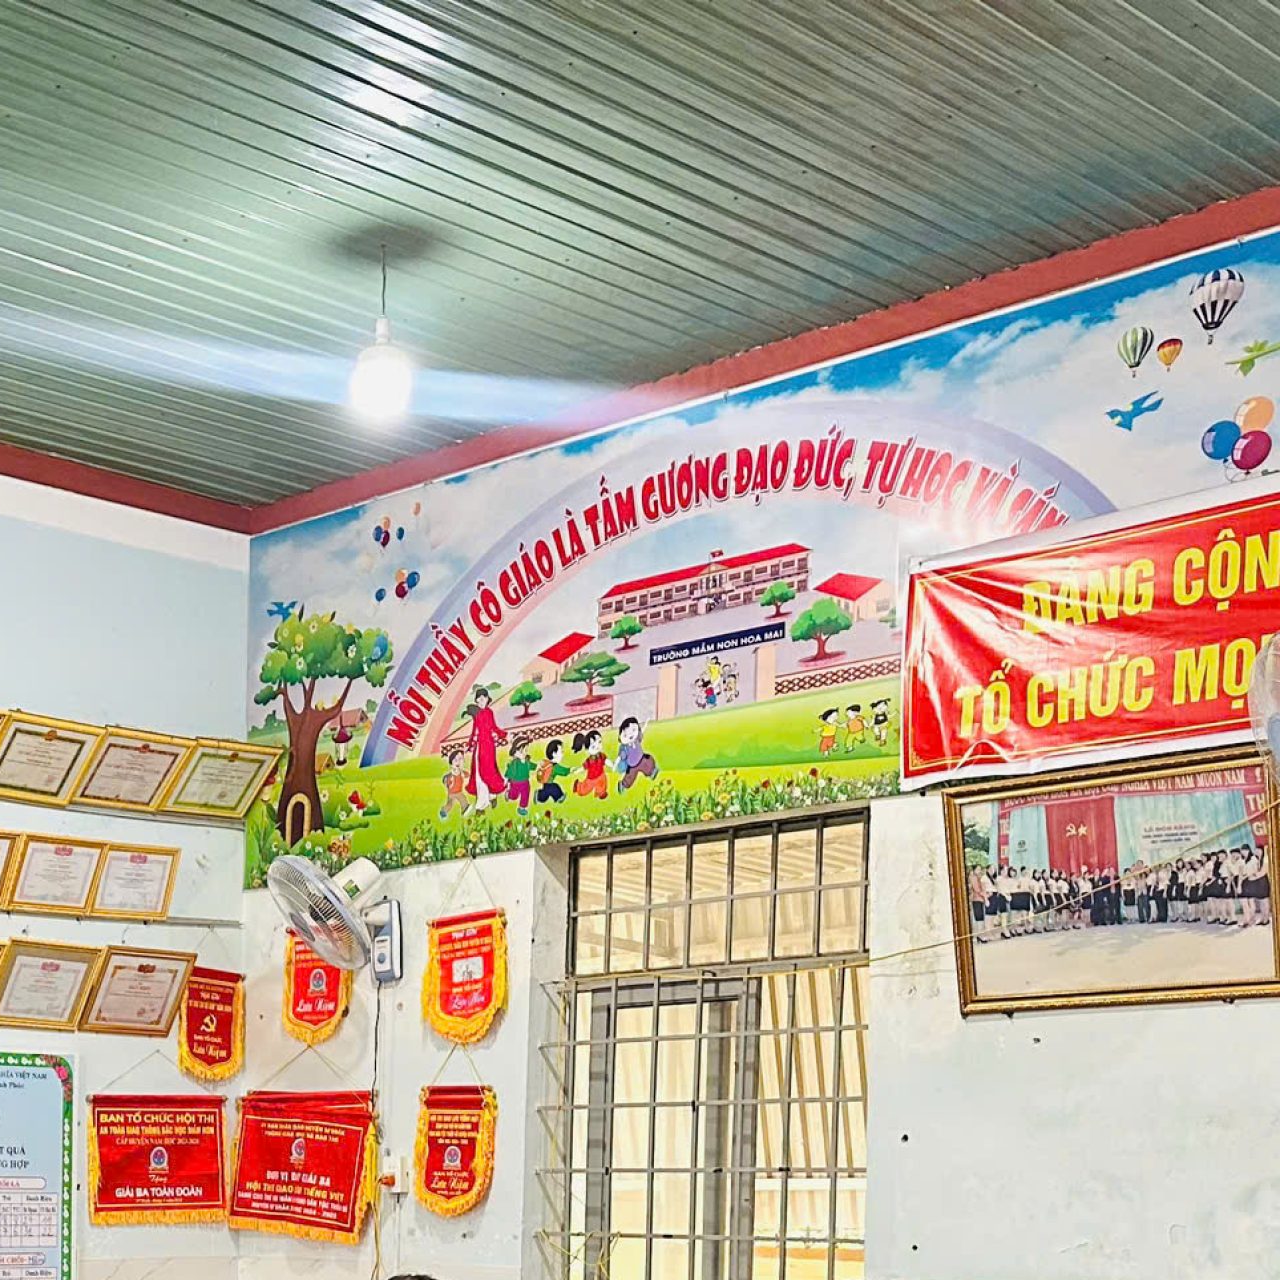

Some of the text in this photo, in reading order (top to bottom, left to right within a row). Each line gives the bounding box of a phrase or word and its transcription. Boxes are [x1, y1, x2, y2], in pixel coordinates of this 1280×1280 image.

[387, 687, 433, 748] MỖI
[416, 617, 475, 695] THẦY
[469, 581, 502, 634] CÔ
[499, 540, 554, 606] GIÁO
[552, 508, 586, 567] LÀ
[584, 476, 637, 546] TẤM
[642, 454, 728, 520] GƯƠNG
[735, 441, 789, 505] ĐẠO
[793, 423, 854, 496] ĐỨC,
[863, 435, 916, 505] TỰ
[653, 630, 783, 663] TRƯỜNG MẦM NON HOA MAI
[956, 658, 1014, 738] TỔ
[1026, 650, 1156, 728] CHỨC
[100, 1111, 215, 1124] BAN TỔ CHỨC HỘI THI
[115, 1185, 203, 1198] GIẢI BA TOÀN ĐOÀN
